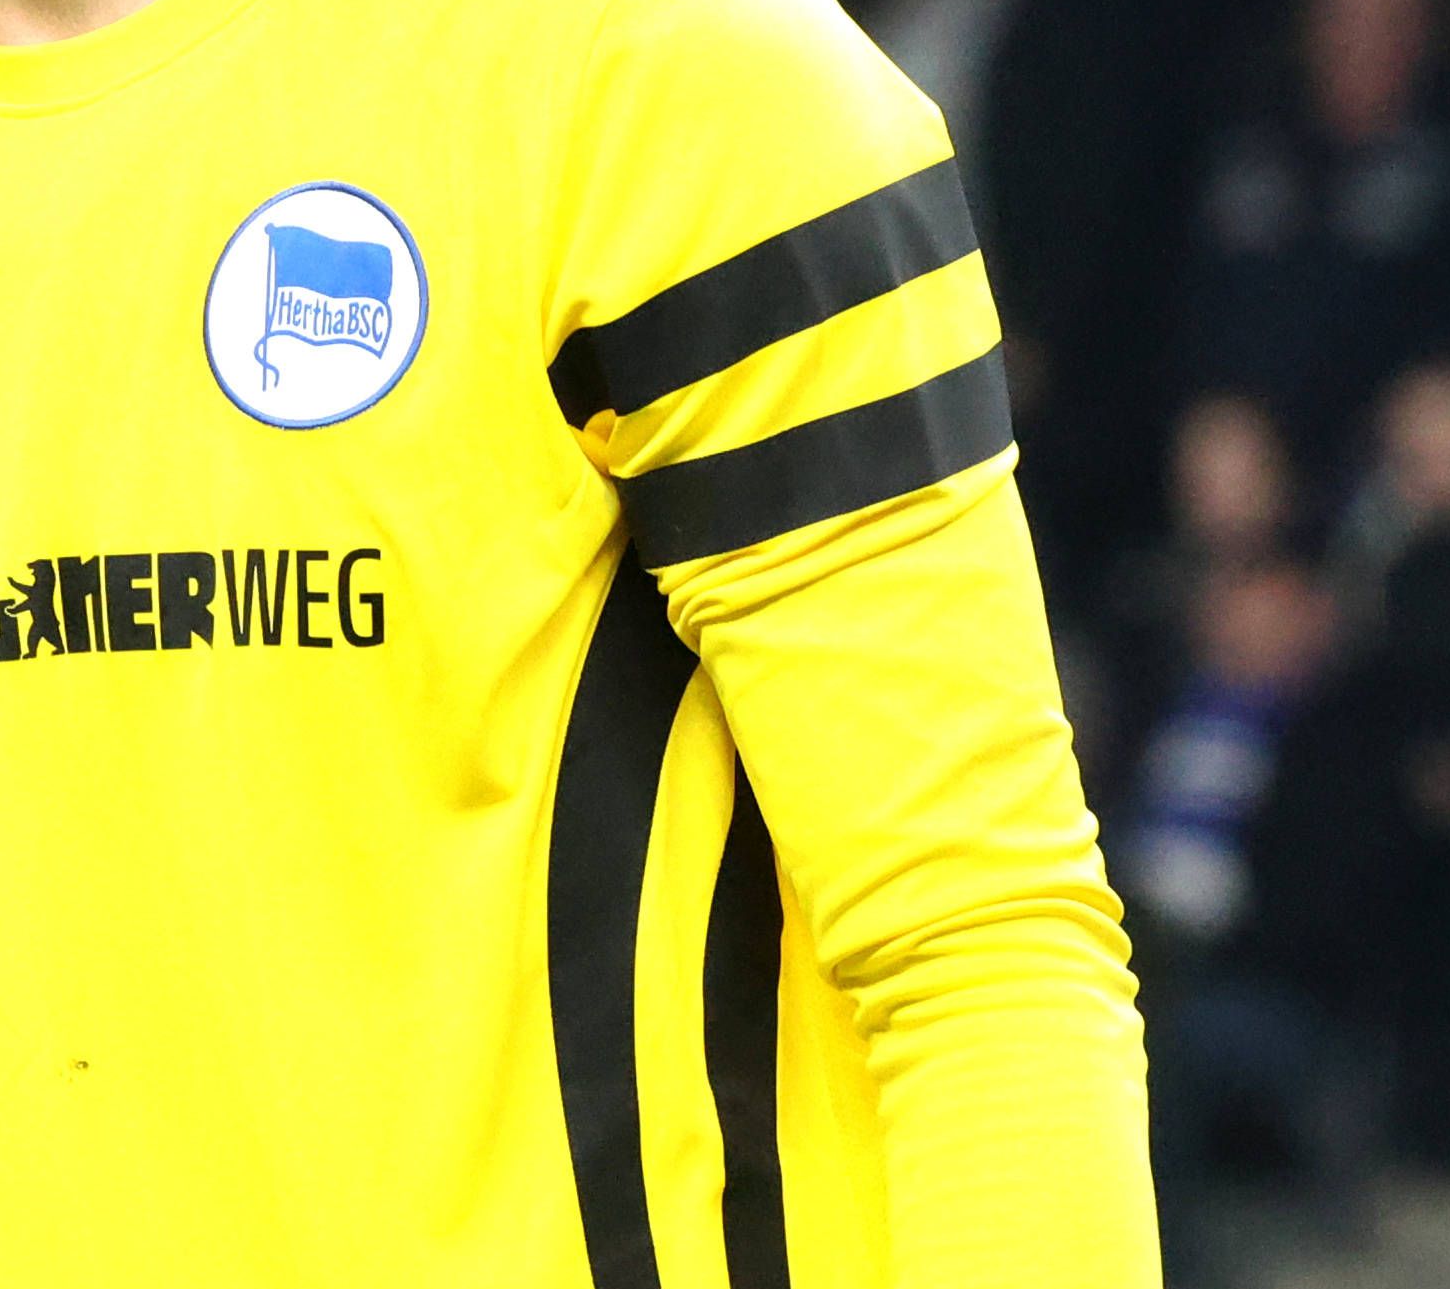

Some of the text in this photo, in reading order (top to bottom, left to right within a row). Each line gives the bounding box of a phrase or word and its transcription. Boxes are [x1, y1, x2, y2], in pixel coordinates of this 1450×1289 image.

[277, 290, 384, 343] Hertha BSC
[221, 547, 385, 649] WEG
